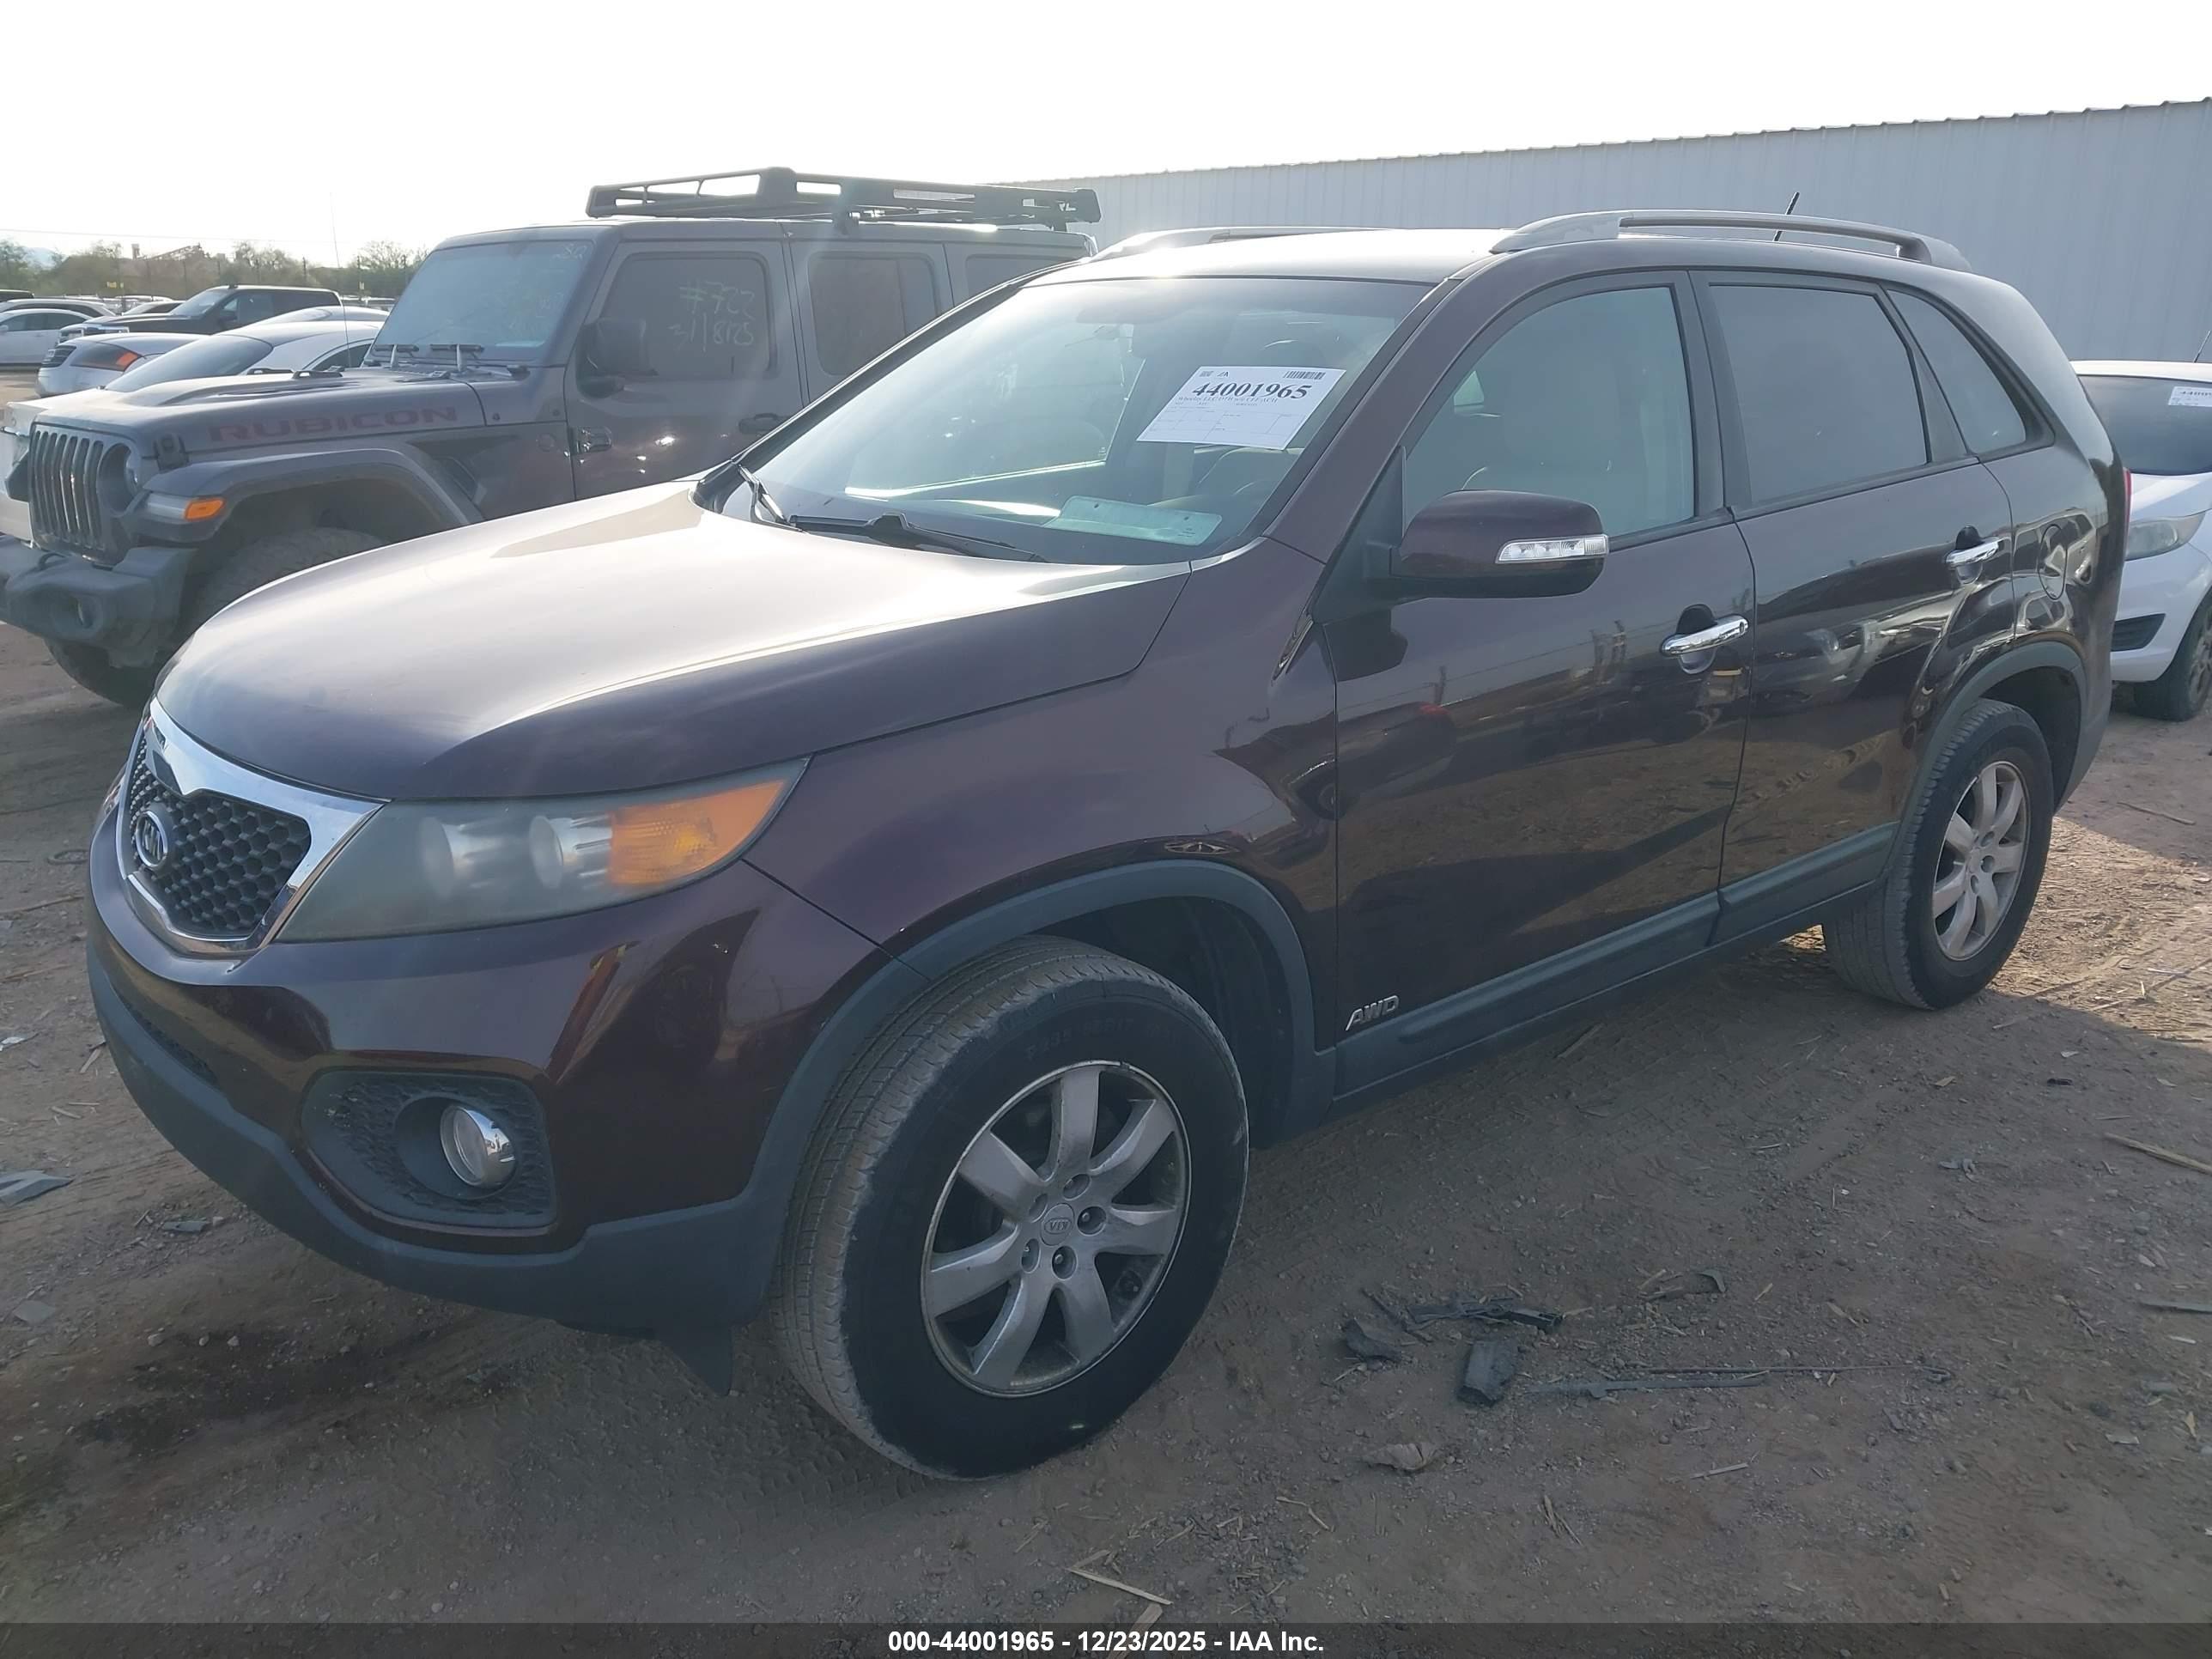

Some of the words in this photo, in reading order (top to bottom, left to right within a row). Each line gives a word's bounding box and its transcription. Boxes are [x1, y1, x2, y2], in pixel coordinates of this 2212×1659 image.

[1192, 381, 1313, 399] 44001965
[207, 407, 459, 442] RUBICON
[1345, 994, 1401, 1031] AWD
